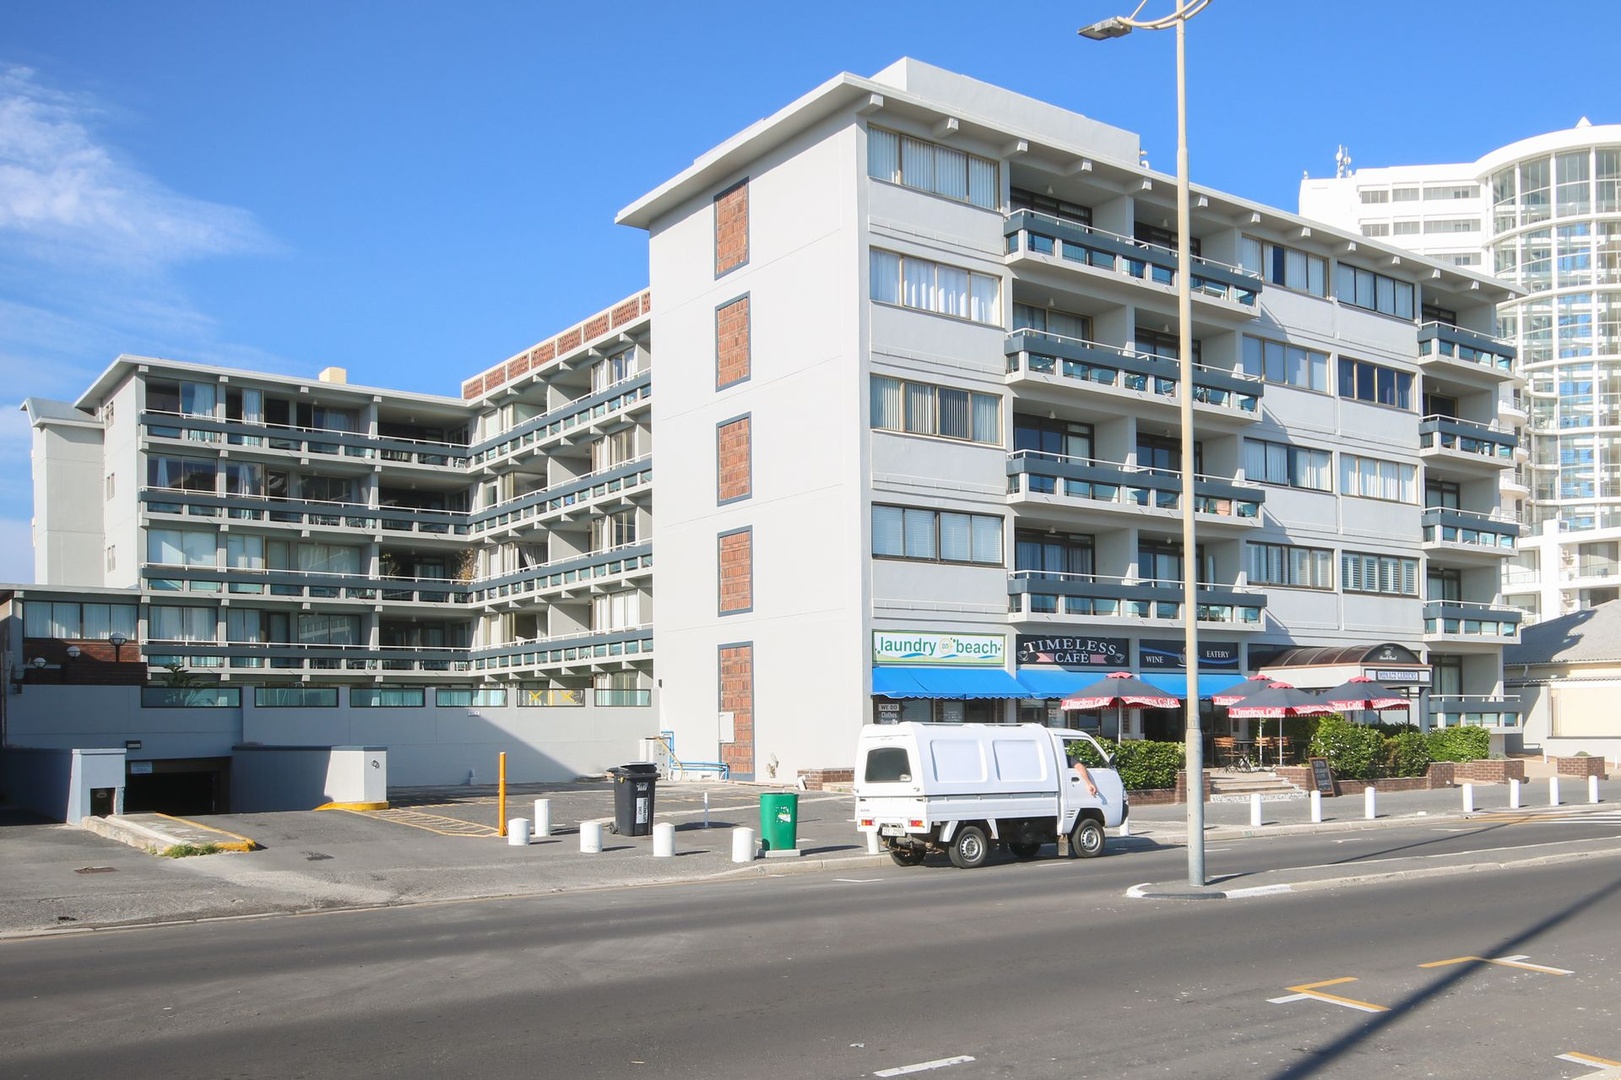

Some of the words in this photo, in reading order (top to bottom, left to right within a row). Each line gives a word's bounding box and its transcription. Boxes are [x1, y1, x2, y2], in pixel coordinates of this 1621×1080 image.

[880, 636, 937, 656] laundry
[956, 639, 998, 653] beach
[1023, 638, 1117, 656] TIMELESS
[1145, 656, 1163, 664] WINE
[1206, 650, 1229, 658] EATERY
[1232, 708, 1264, 716] Timeless
